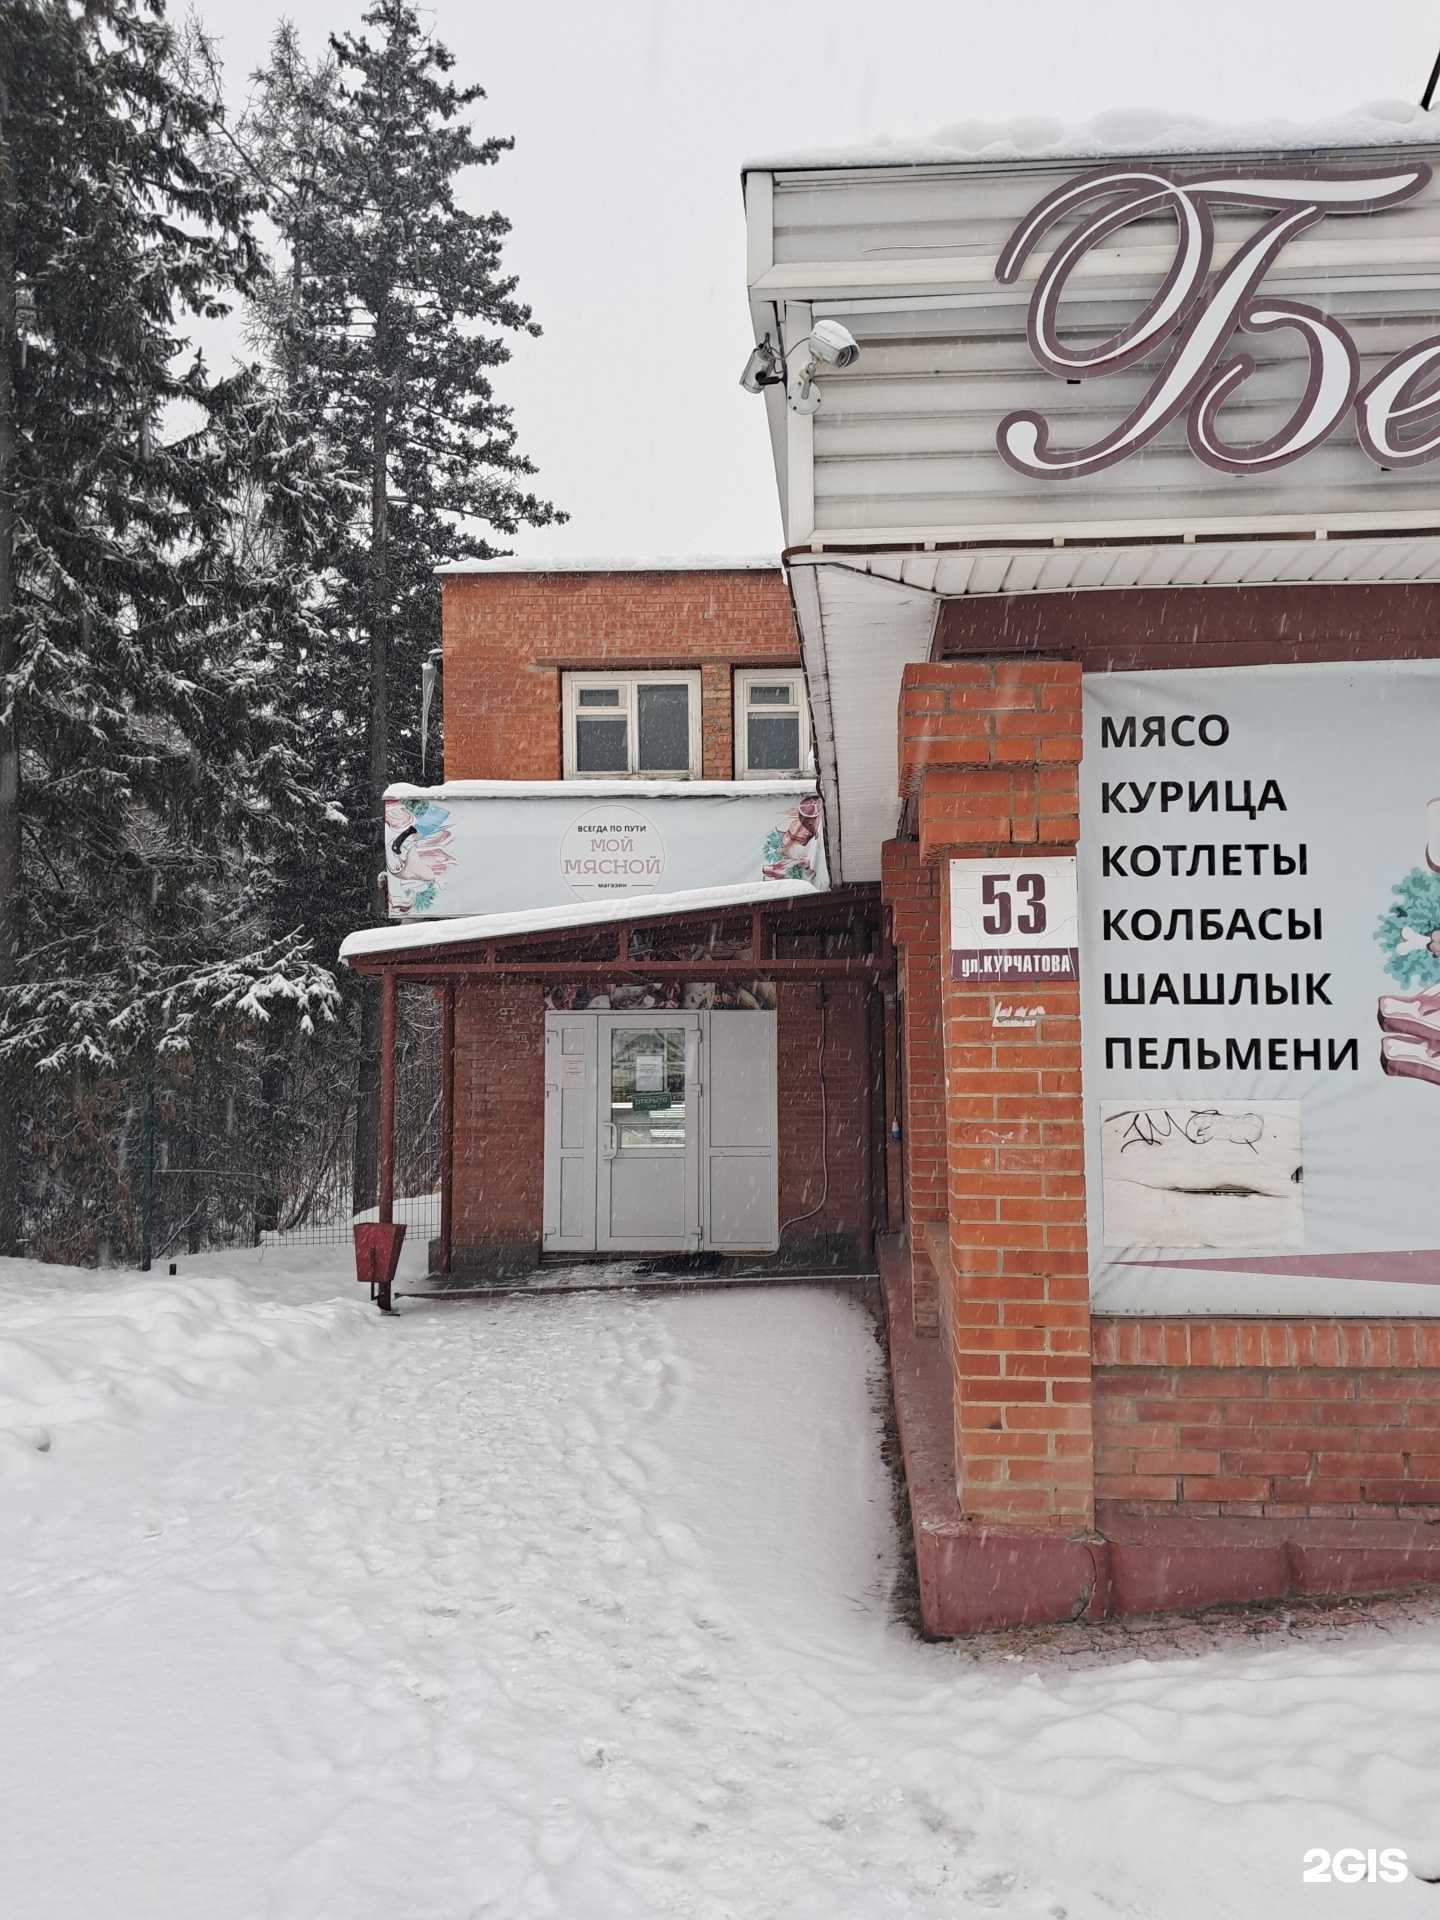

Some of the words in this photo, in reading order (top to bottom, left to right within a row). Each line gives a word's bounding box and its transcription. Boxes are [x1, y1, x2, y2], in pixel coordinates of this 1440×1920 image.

[1101, 714, 1230, 749] МЯСО
[1101, 779, 1288, 820] КУРИЦА
[577, 825, 608, 834] ВСЕГДА
[610, 825, 622, 833] ПО
[624, 825, 647, 833] ПУТИ
[591, 836, 634, 852] МОЙ
[564, 856, 661, 874] МЯСНОЙ
[1102, 843, 1308, 877] КОТЛЕТЫ
[982, 873, 1047, 935] 53
[1103, 908, 1323, 941] КОЛБАСЫ
[1103, 973, 1334, 1006] ШАШЛЫК
[1104, 1037, 1359, 1071] ПЕЛЬМЕНИ
